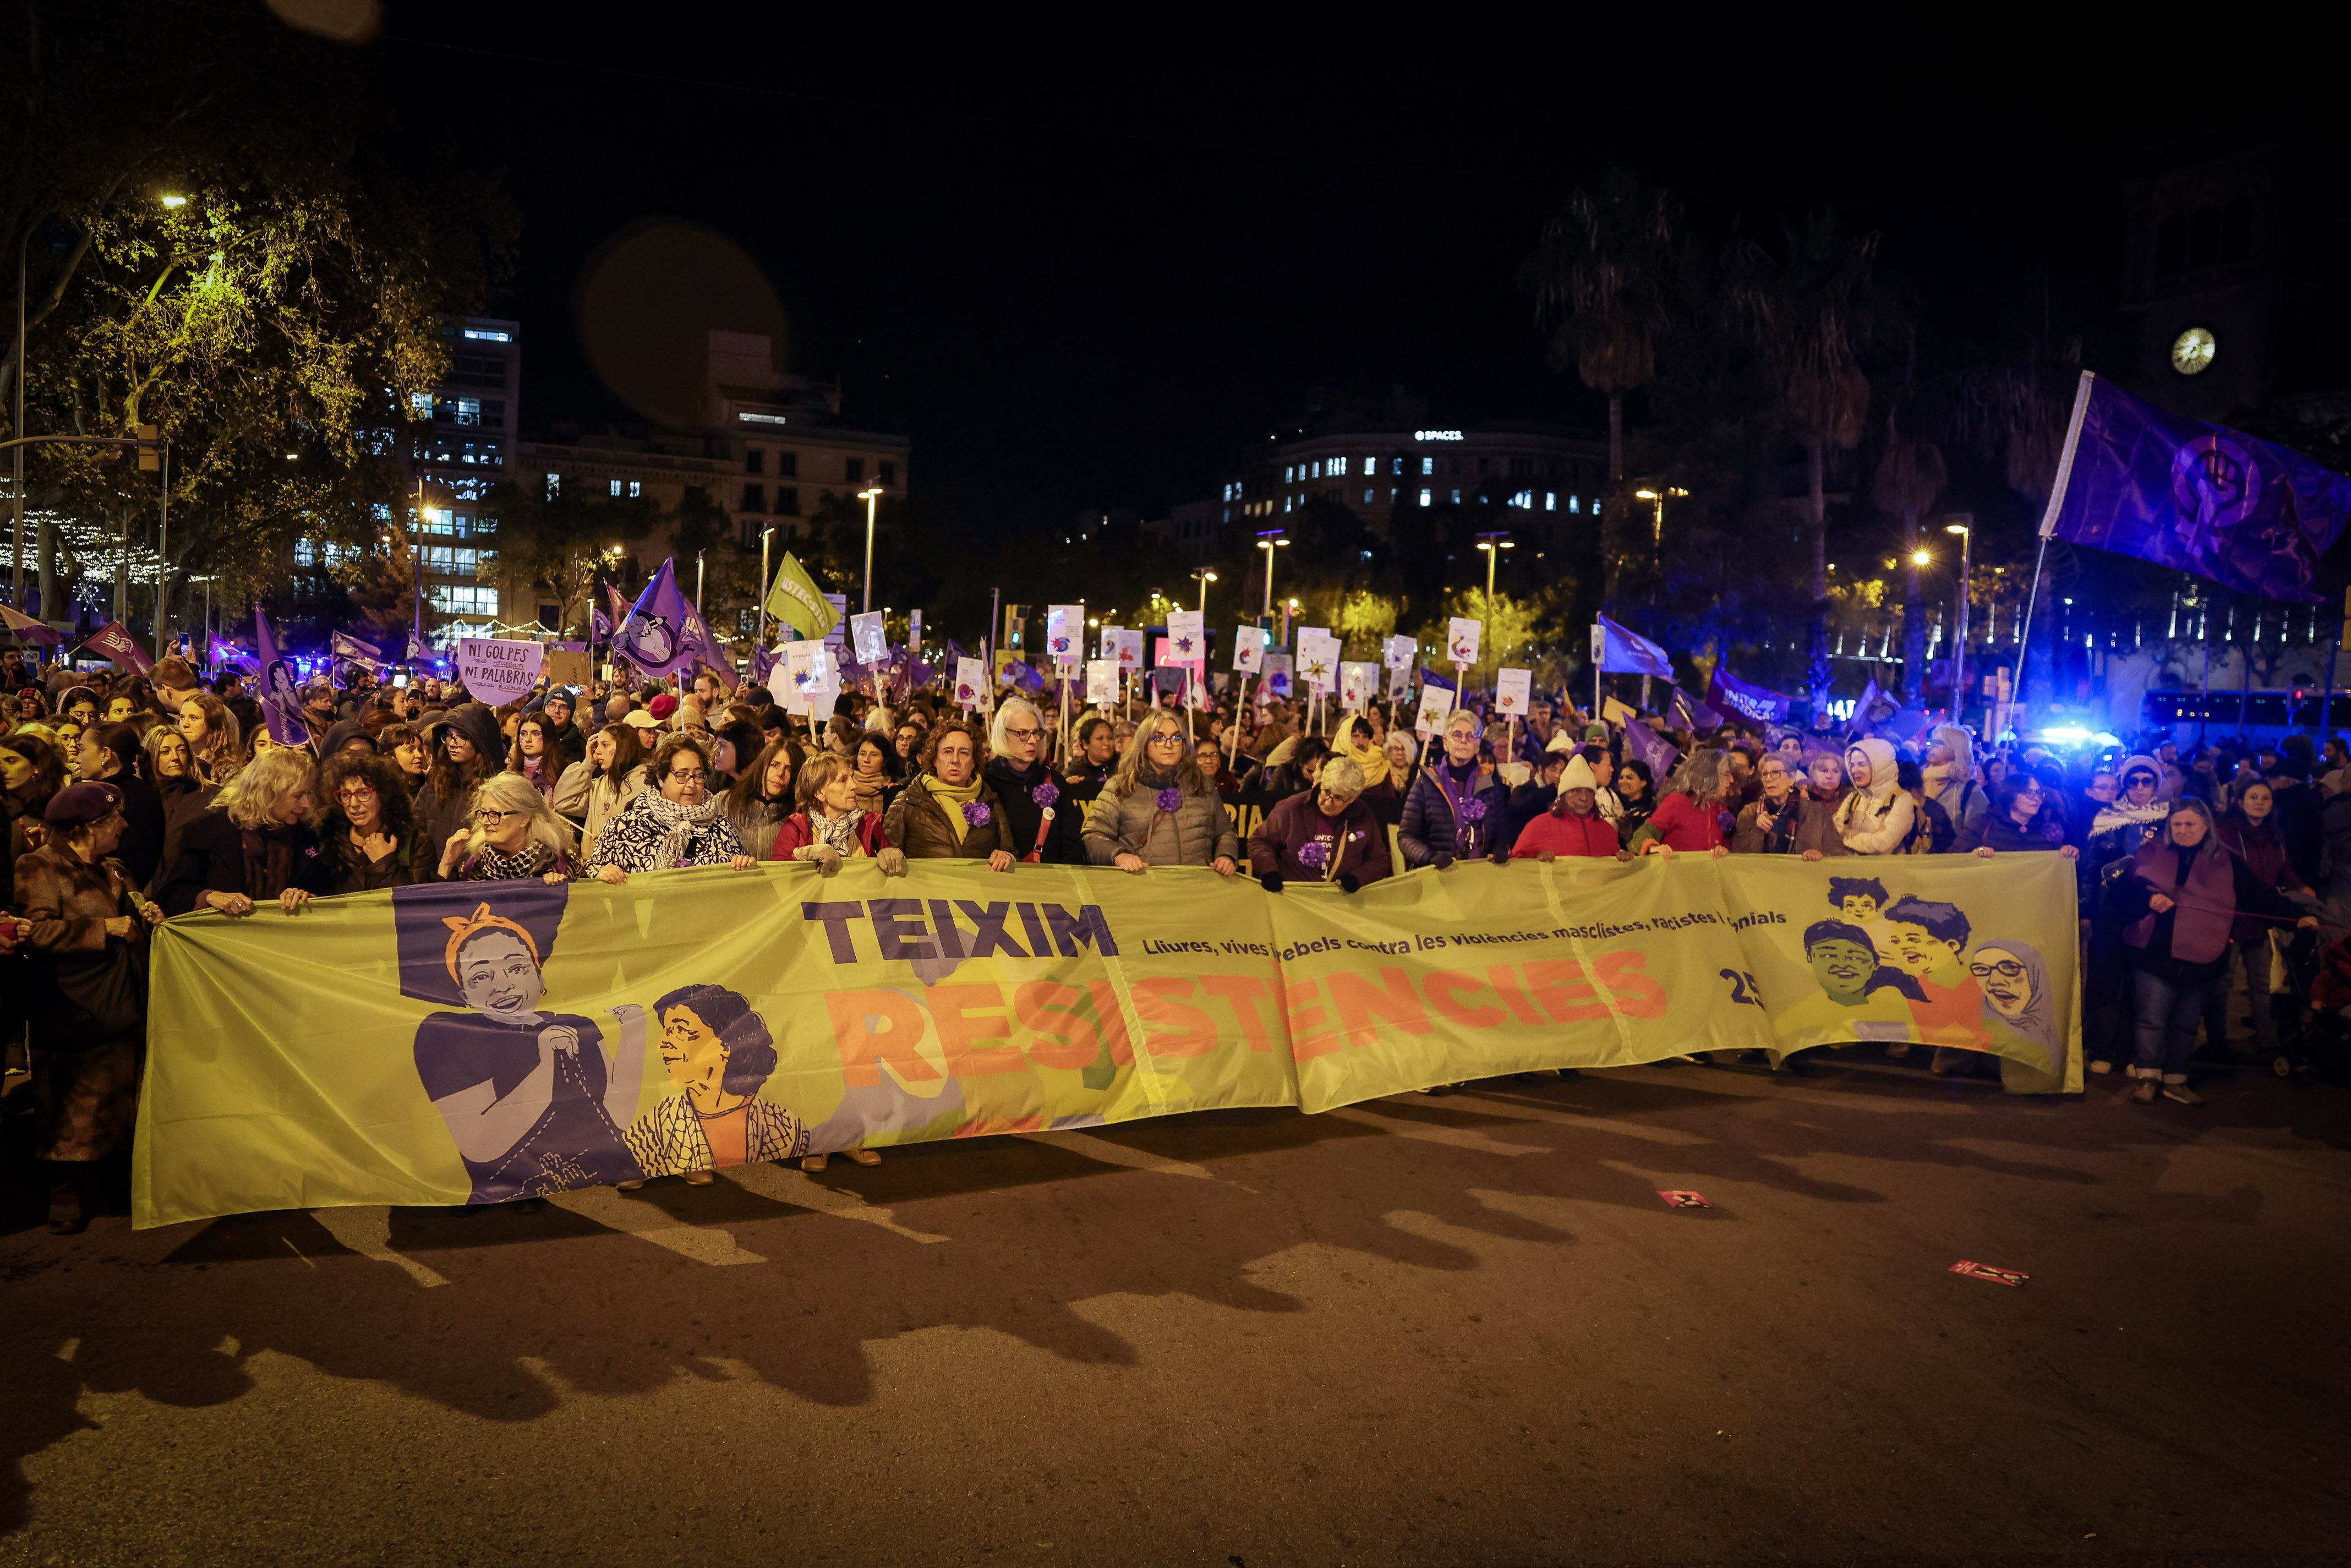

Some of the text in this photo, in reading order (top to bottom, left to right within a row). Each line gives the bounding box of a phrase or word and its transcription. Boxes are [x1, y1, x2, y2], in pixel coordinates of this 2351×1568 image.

[465, 666, 533, 686] NI PALABRAS
[469, 644, 529, 663] NI GOLPES
[801, 898, 1120, 964] TEIXIM
[1142, 939, 1220, 957] Lliures,
[1220, 939, 1270, 957] vives
[1346, 938, 1412, 955] contra
[1414, 934, 1447, 952] les
[1450, 931, 1549, 946] violències
[1552, 919, 1652, 939] masclistes,
[1651, 911, 1717, 931] racistes
[824, 949, 1667, 1089] RESISTÈNCIES
